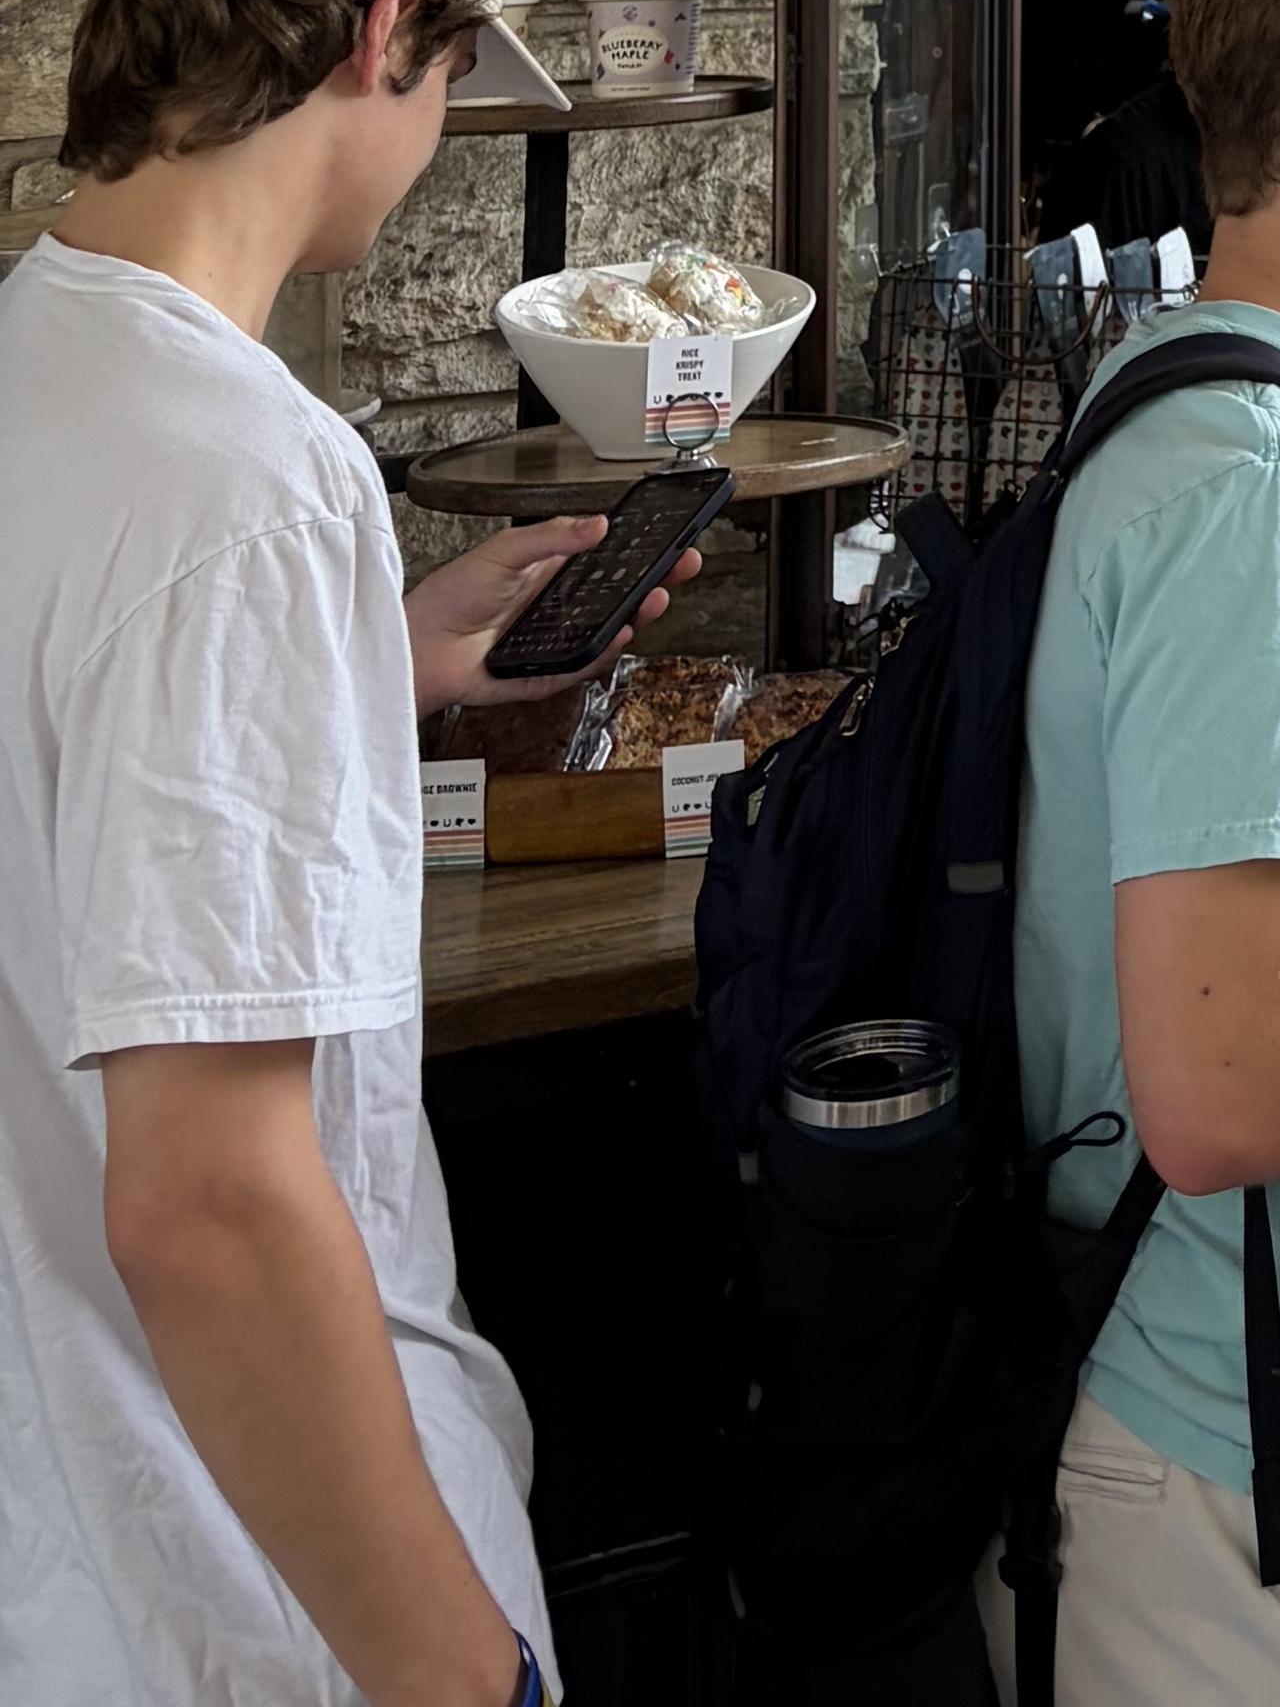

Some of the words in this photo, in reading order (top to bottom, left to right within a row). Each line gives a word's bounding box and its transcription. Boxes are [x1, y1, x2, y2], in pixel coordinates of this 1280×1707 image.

[602, 39, 663, 53] BLUEBERRY
[612, 50, 649, 61] MAPLE
[437, 783, 477, 794] BROWNIE
